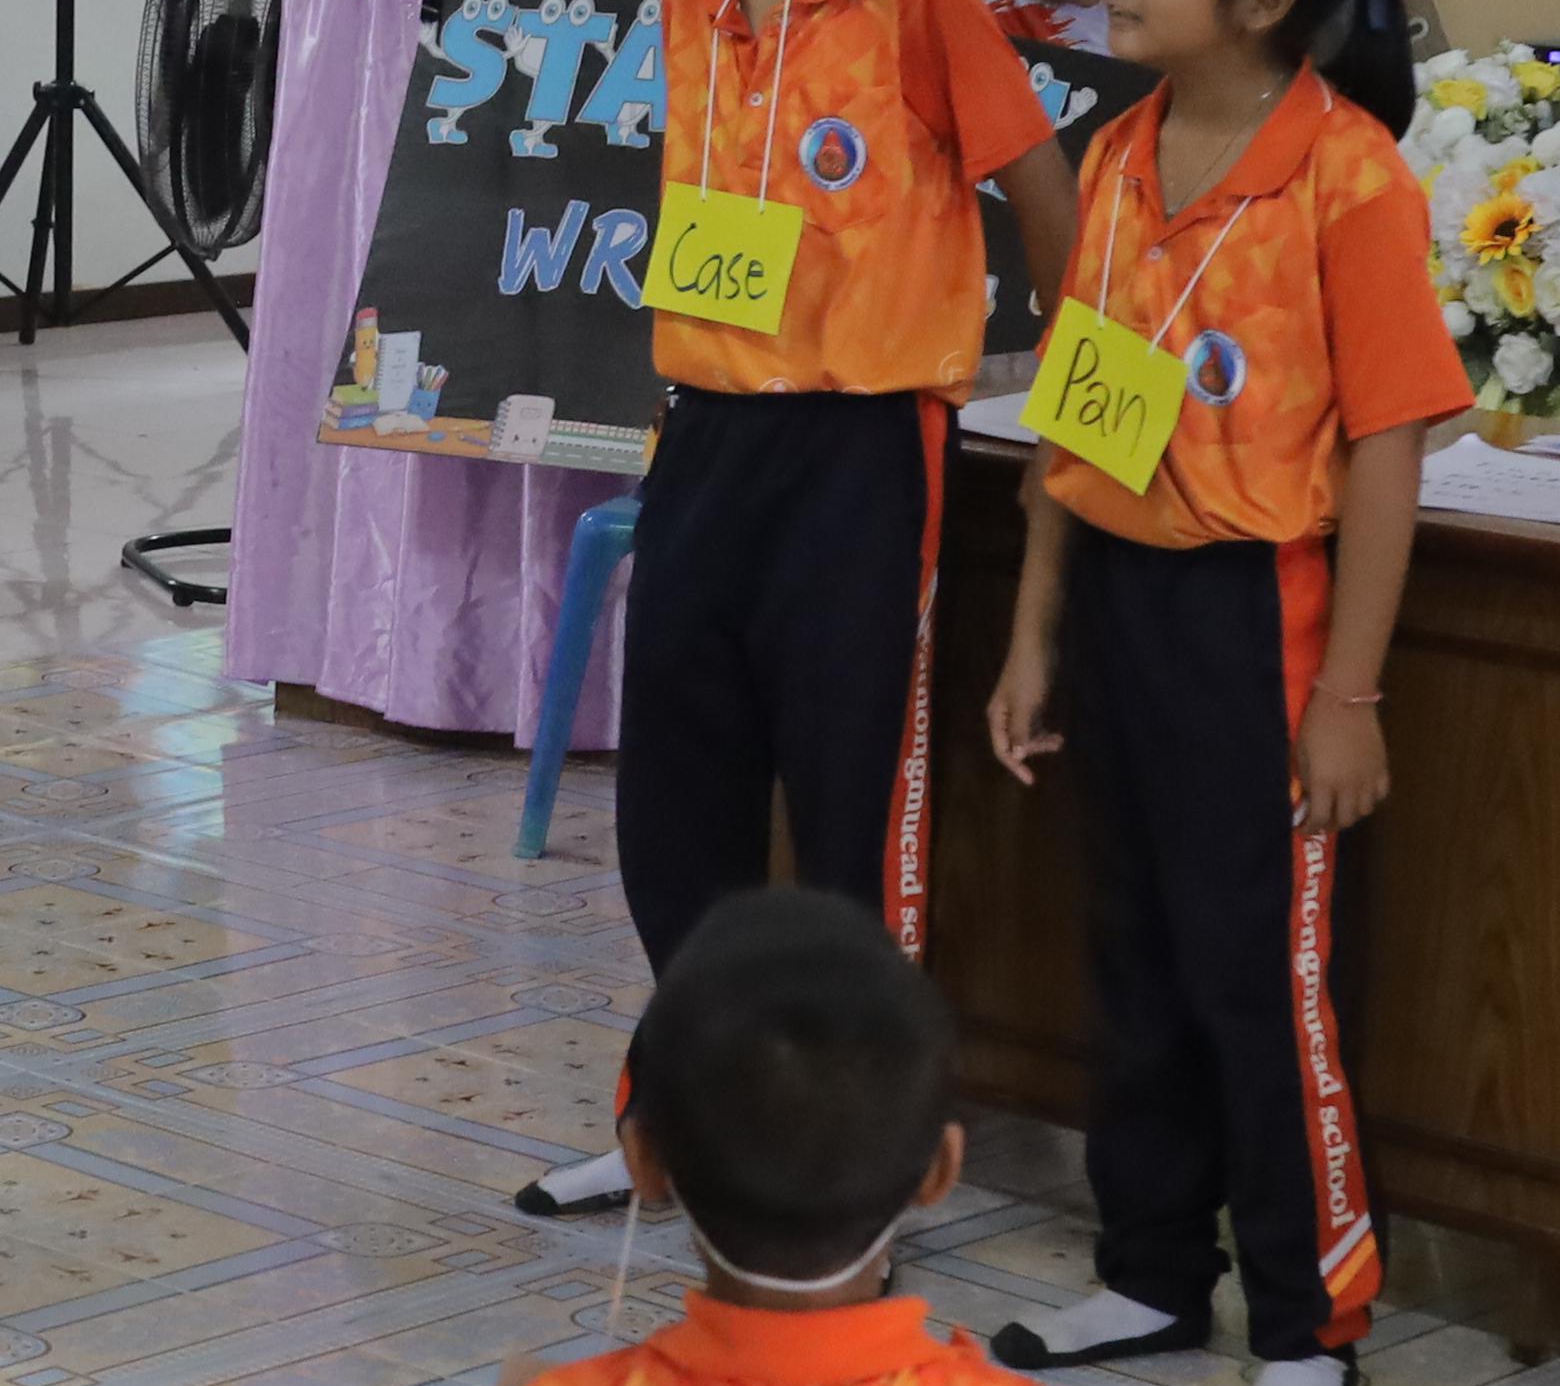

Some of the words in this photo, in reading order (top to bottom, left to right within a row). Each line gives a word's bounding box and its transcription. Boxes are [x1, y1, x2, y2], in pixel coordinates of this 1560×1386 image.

[669, 221, 768, 301] Case
[1054, 327, 1148, 458] Pan
[1318, 1104, 1357, 1230] school
